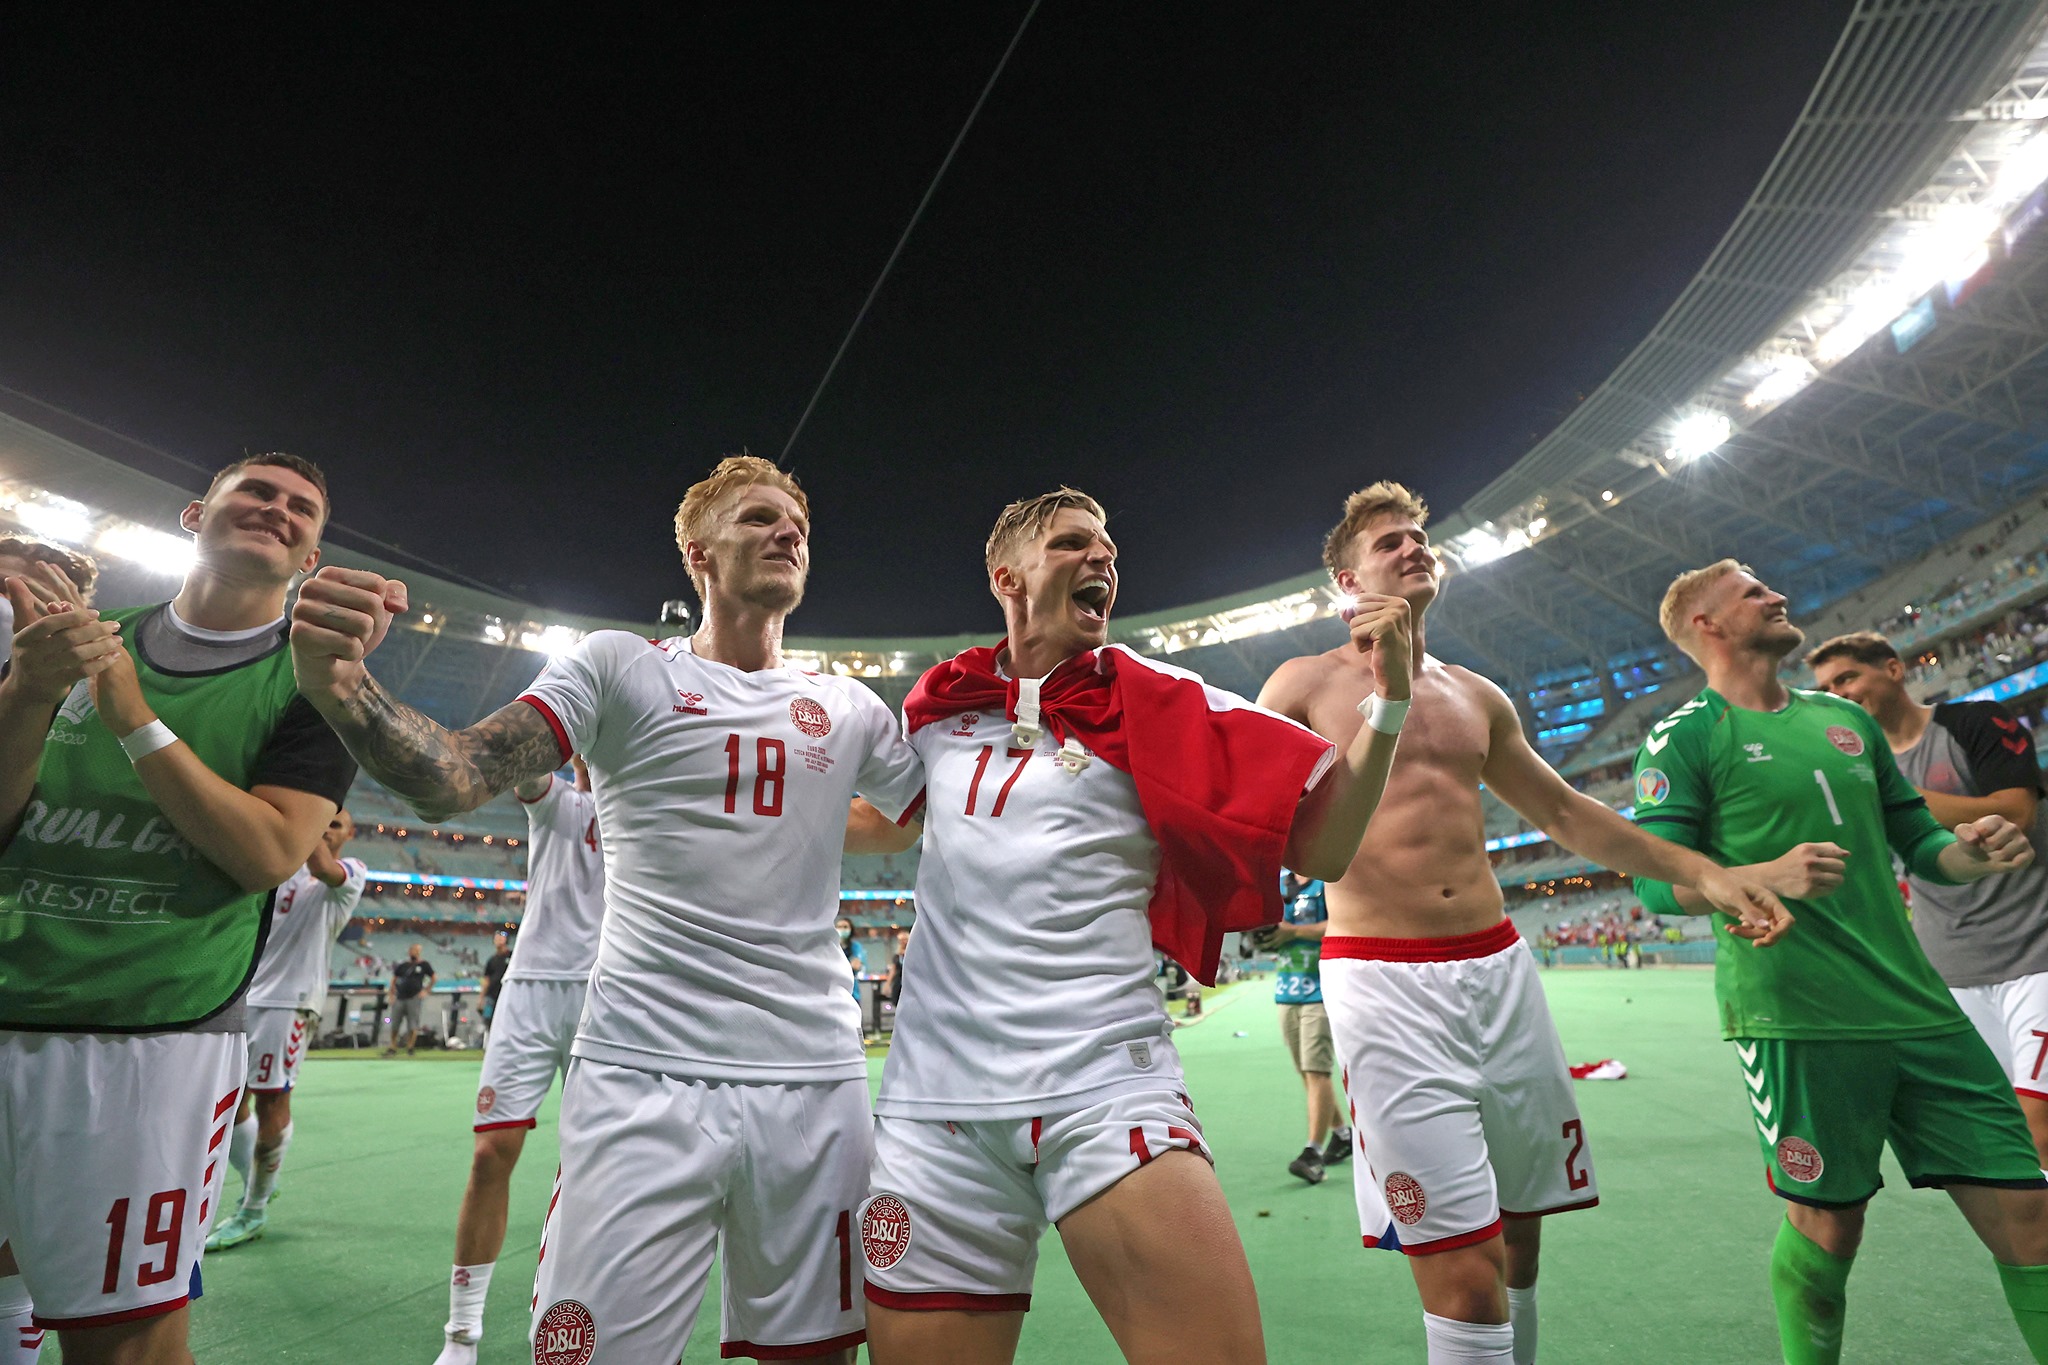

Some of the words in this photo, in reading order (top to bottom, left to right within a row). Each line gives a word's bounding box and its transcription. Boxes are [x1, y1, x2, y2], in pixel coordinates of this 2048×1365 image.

[797, 710, 822, 724] DBU
[724, 733, 786, 817] 18
[964, 745, 1034, 817] 17
[1813, 769, 1843, 825] 1
[585, 817, 597, 852] 4
[18, 878, 177, 914] RESPECT
[257, 1053, 273, 1083] 9
[1562, 1118, 1588, 1191] 2
[1392, 1190, 1417, 1207] DBU
[102, 1188, 187, 1295] 19
[871, 1219, 899, 1242] DBU
[871, 1255, 890, 1267] 1889
[536, 1327, 546, 1365] ANSK
[545, 1328, 582, 1353] DBU
